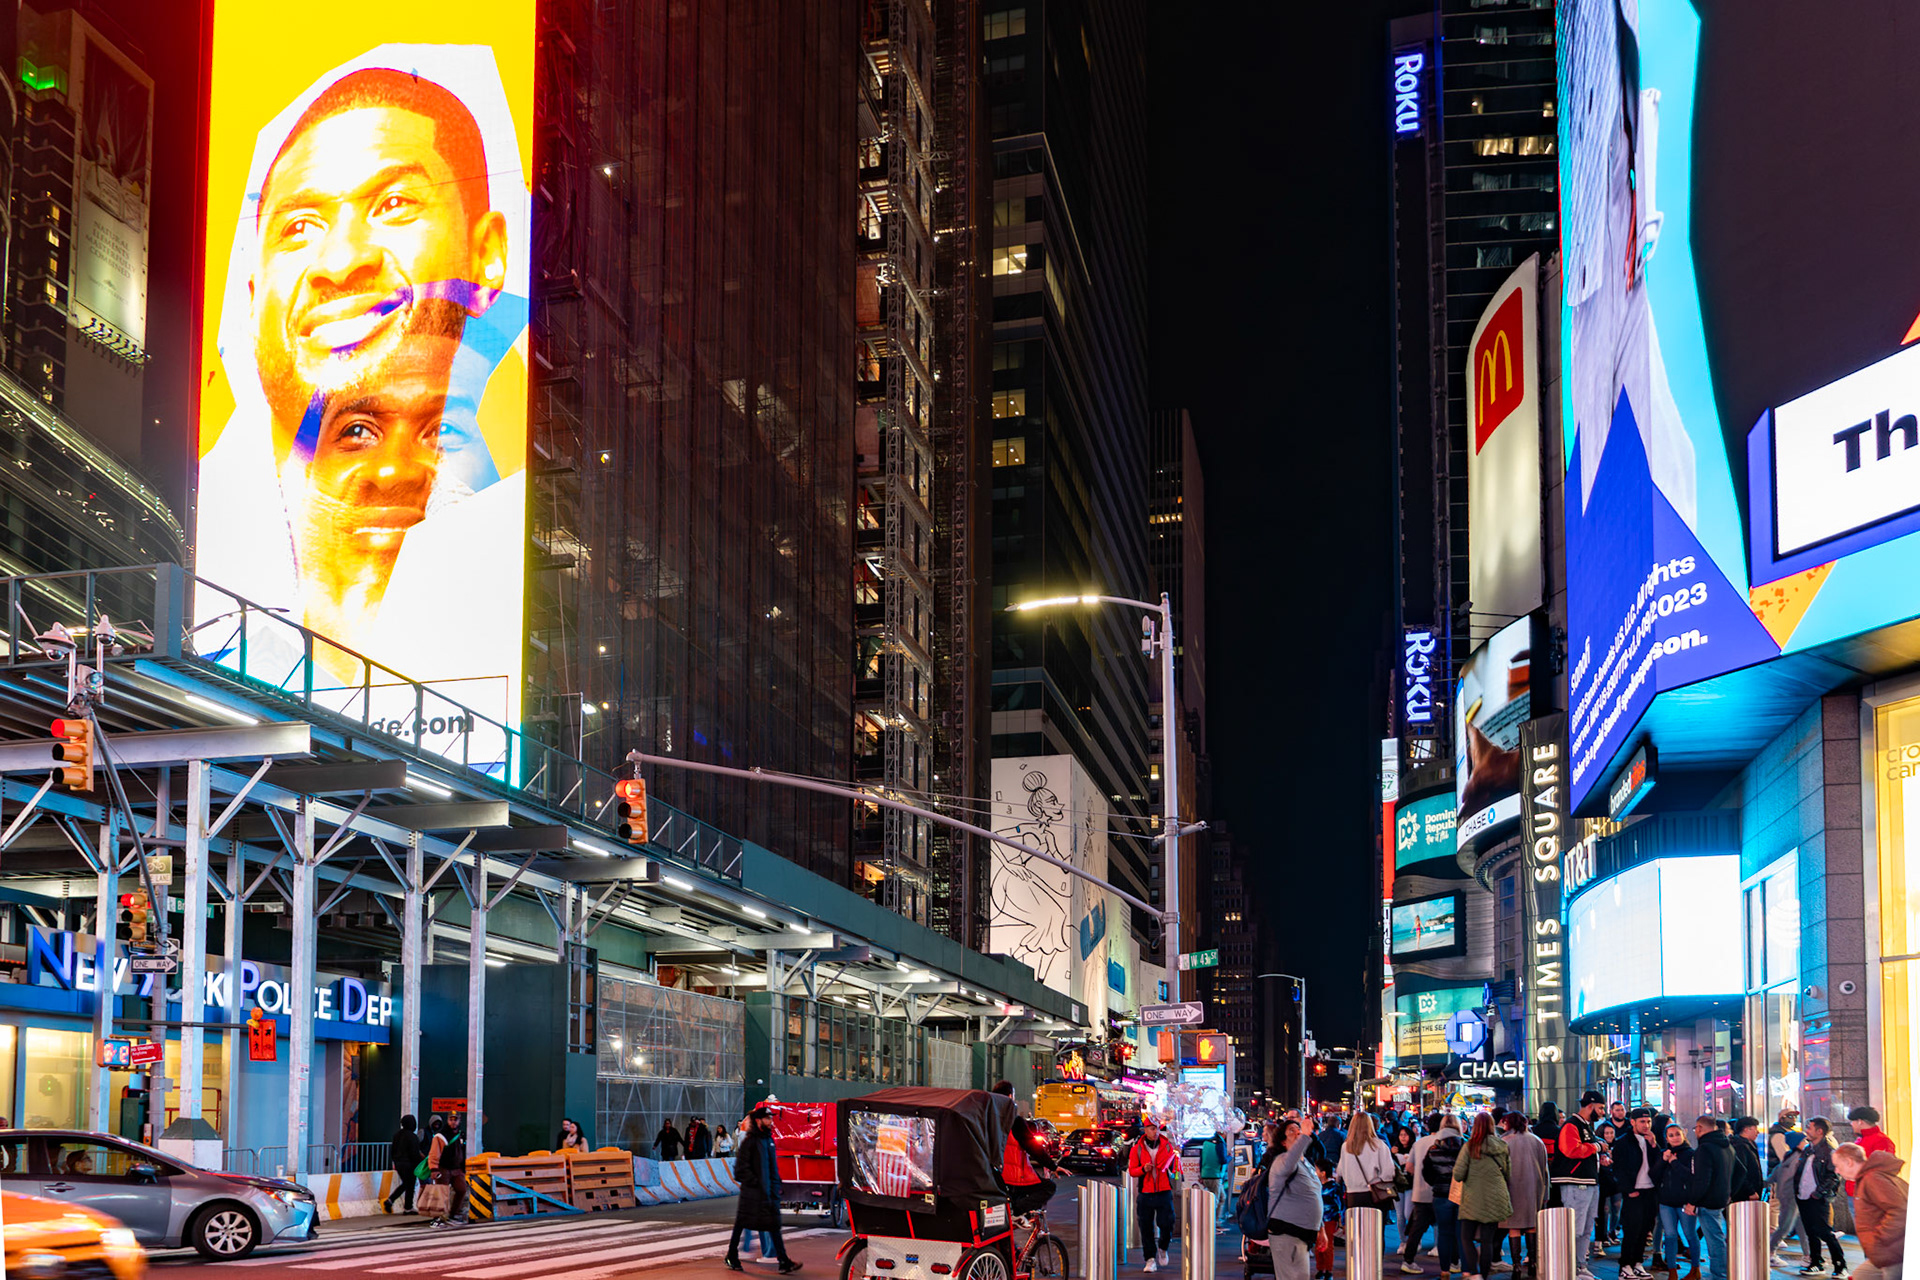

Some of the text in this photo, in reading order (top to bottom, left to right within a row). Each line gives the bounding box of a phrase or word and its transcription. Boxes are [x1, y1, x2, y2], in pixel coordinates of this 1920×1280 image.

[1833, 408, 1919, 473] Th
[1644, 555, 1696, 600] rights
[1464, 813, 1487, 837] CHASE
[1563, 832, 1597, 898] AT&T
[1534, 743, 1561, 1063] 3 TIMES SQUARE
[134, 960, 172, 968] ONE WAY
[1190, 954, 1198, 968] W
[240, 959, 332, 1020] POLE
[1146, 1008, 1194, 1020] ONE WAY
